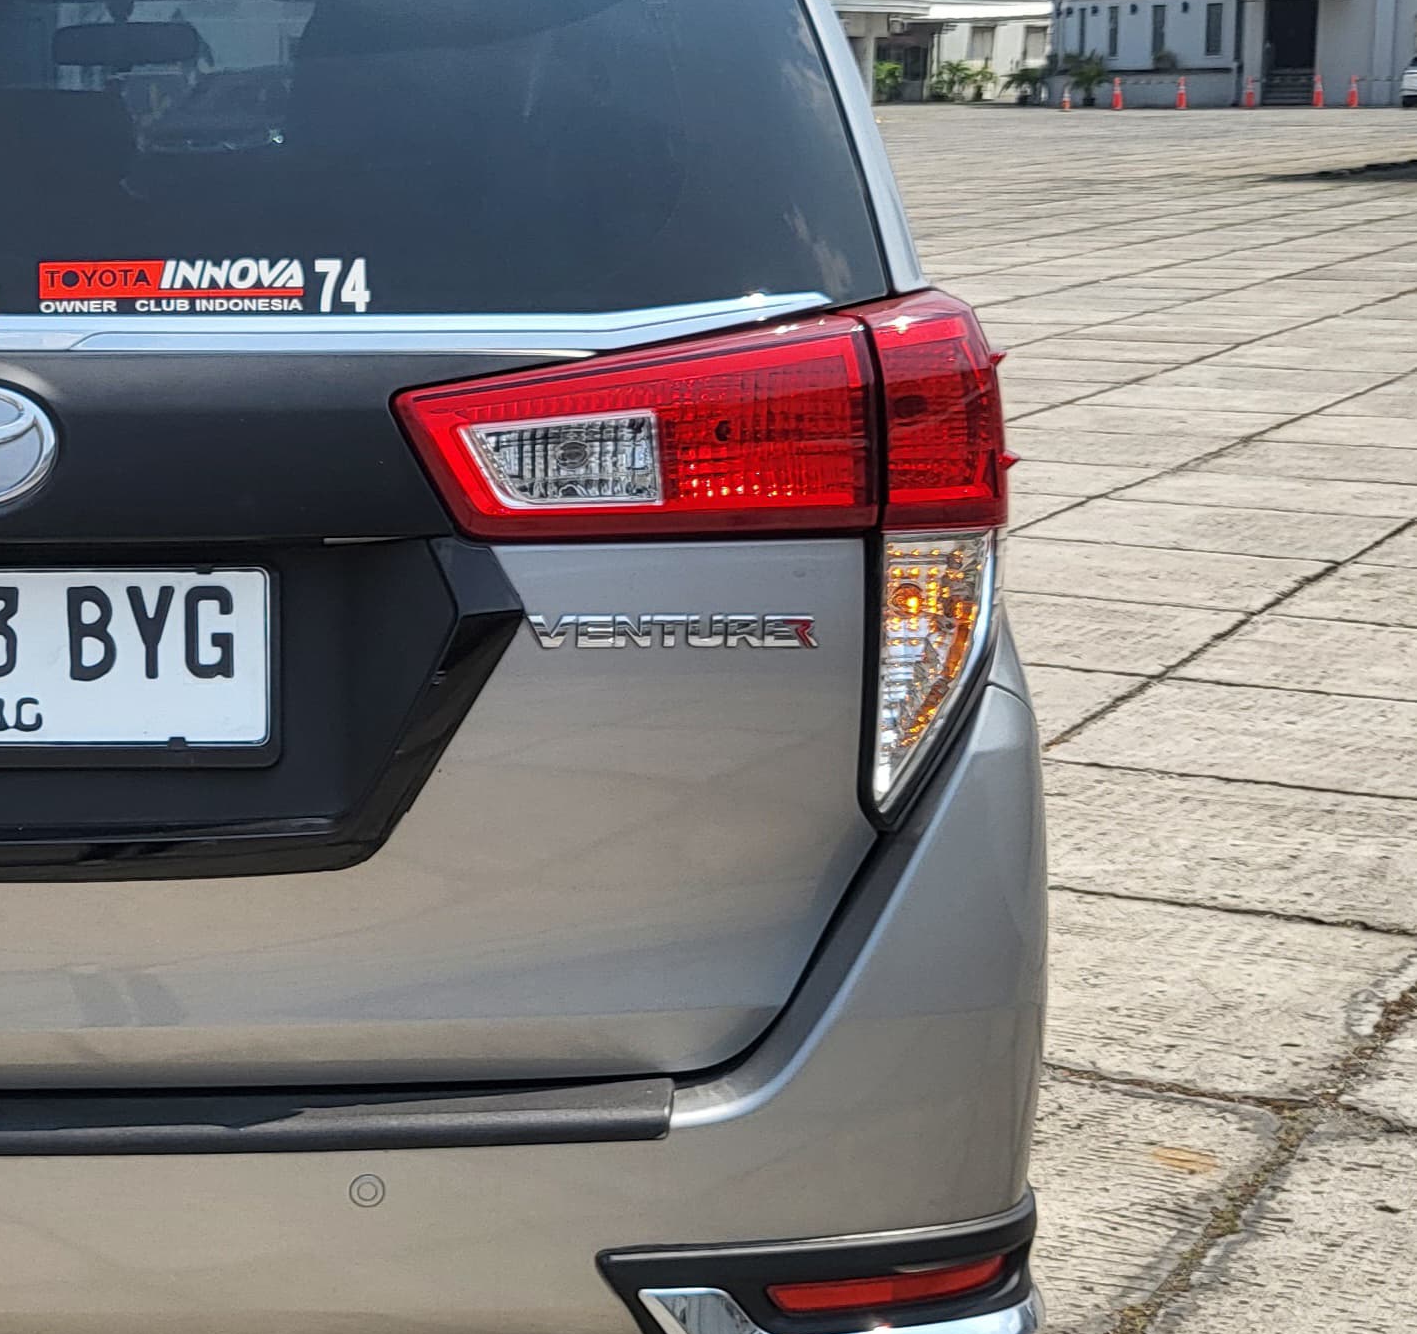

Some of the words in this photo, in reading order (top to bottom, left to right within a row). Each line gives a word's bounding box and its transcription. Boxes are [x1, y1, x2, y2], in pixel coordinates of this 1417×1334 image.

[39, 300, 118, 314] OWNER
[134, 299, 190, 313] CLUB
[194, 298, 304, 313] INDONESIA
[44, 268, 152, 290] TOYOTA
[159, 258, 305, 290] INNOVA
[313, 258, 372, 313] 74
[67, 584, 236, 680] BYG
